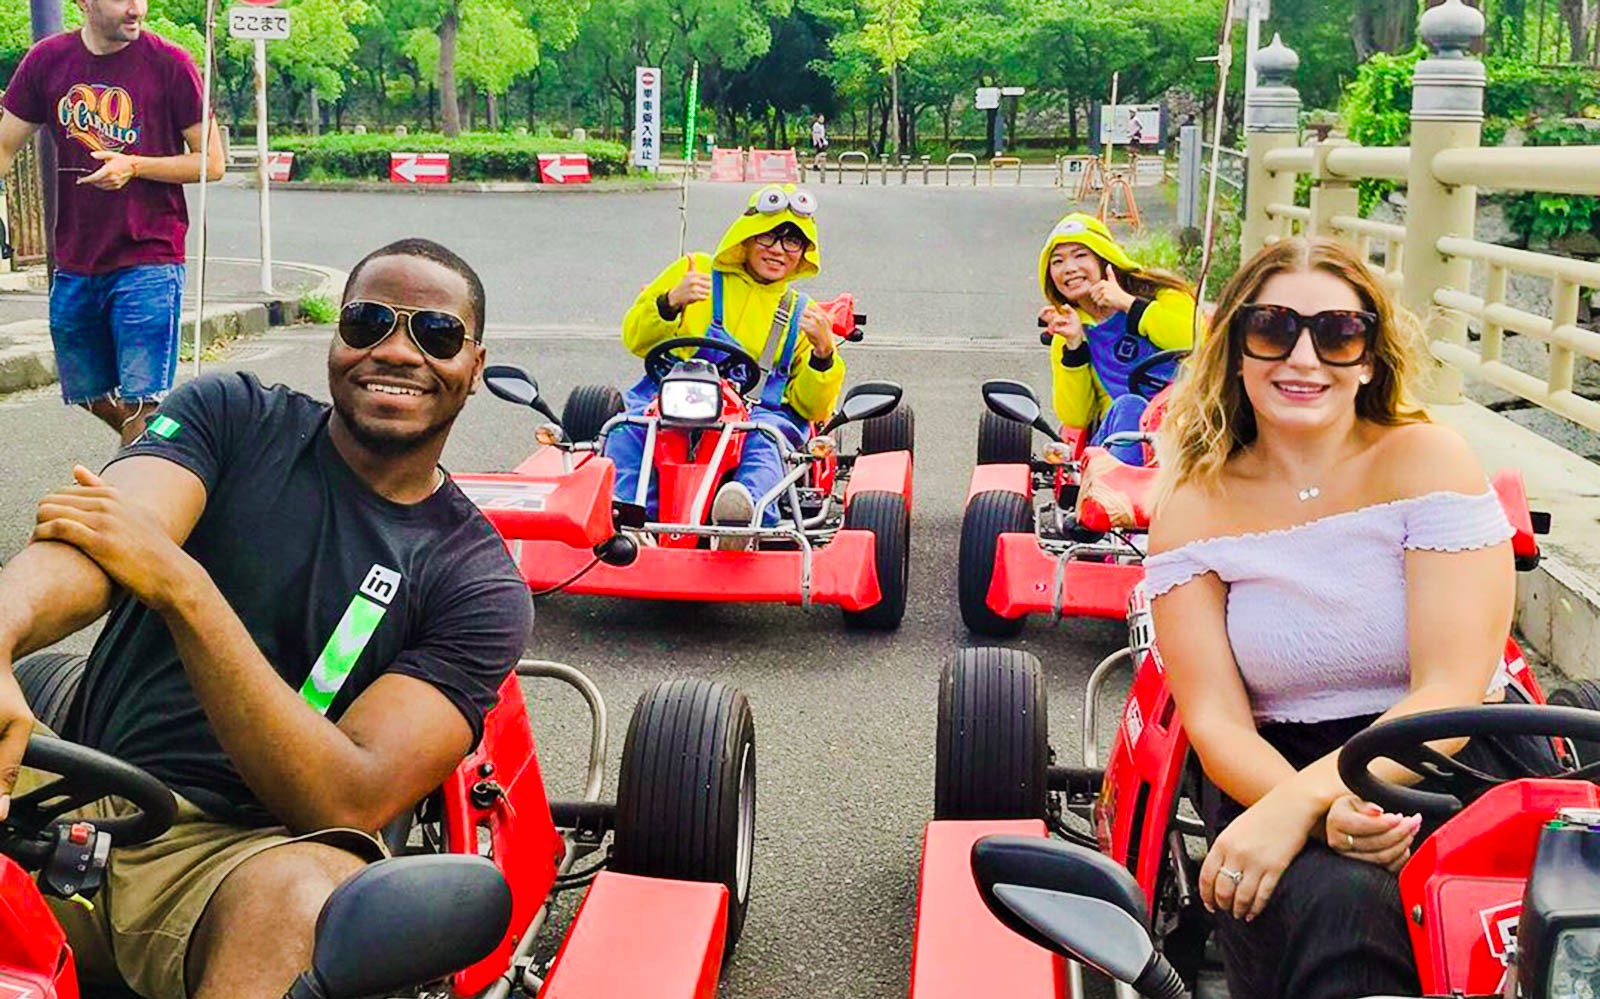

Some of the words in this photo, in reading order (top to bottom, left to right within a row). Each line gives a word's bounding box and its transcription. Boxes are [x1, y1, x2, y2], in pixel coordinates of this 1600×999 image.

[233, 15, 287, 32] ここまで
[367, 570, 392, 597] in
